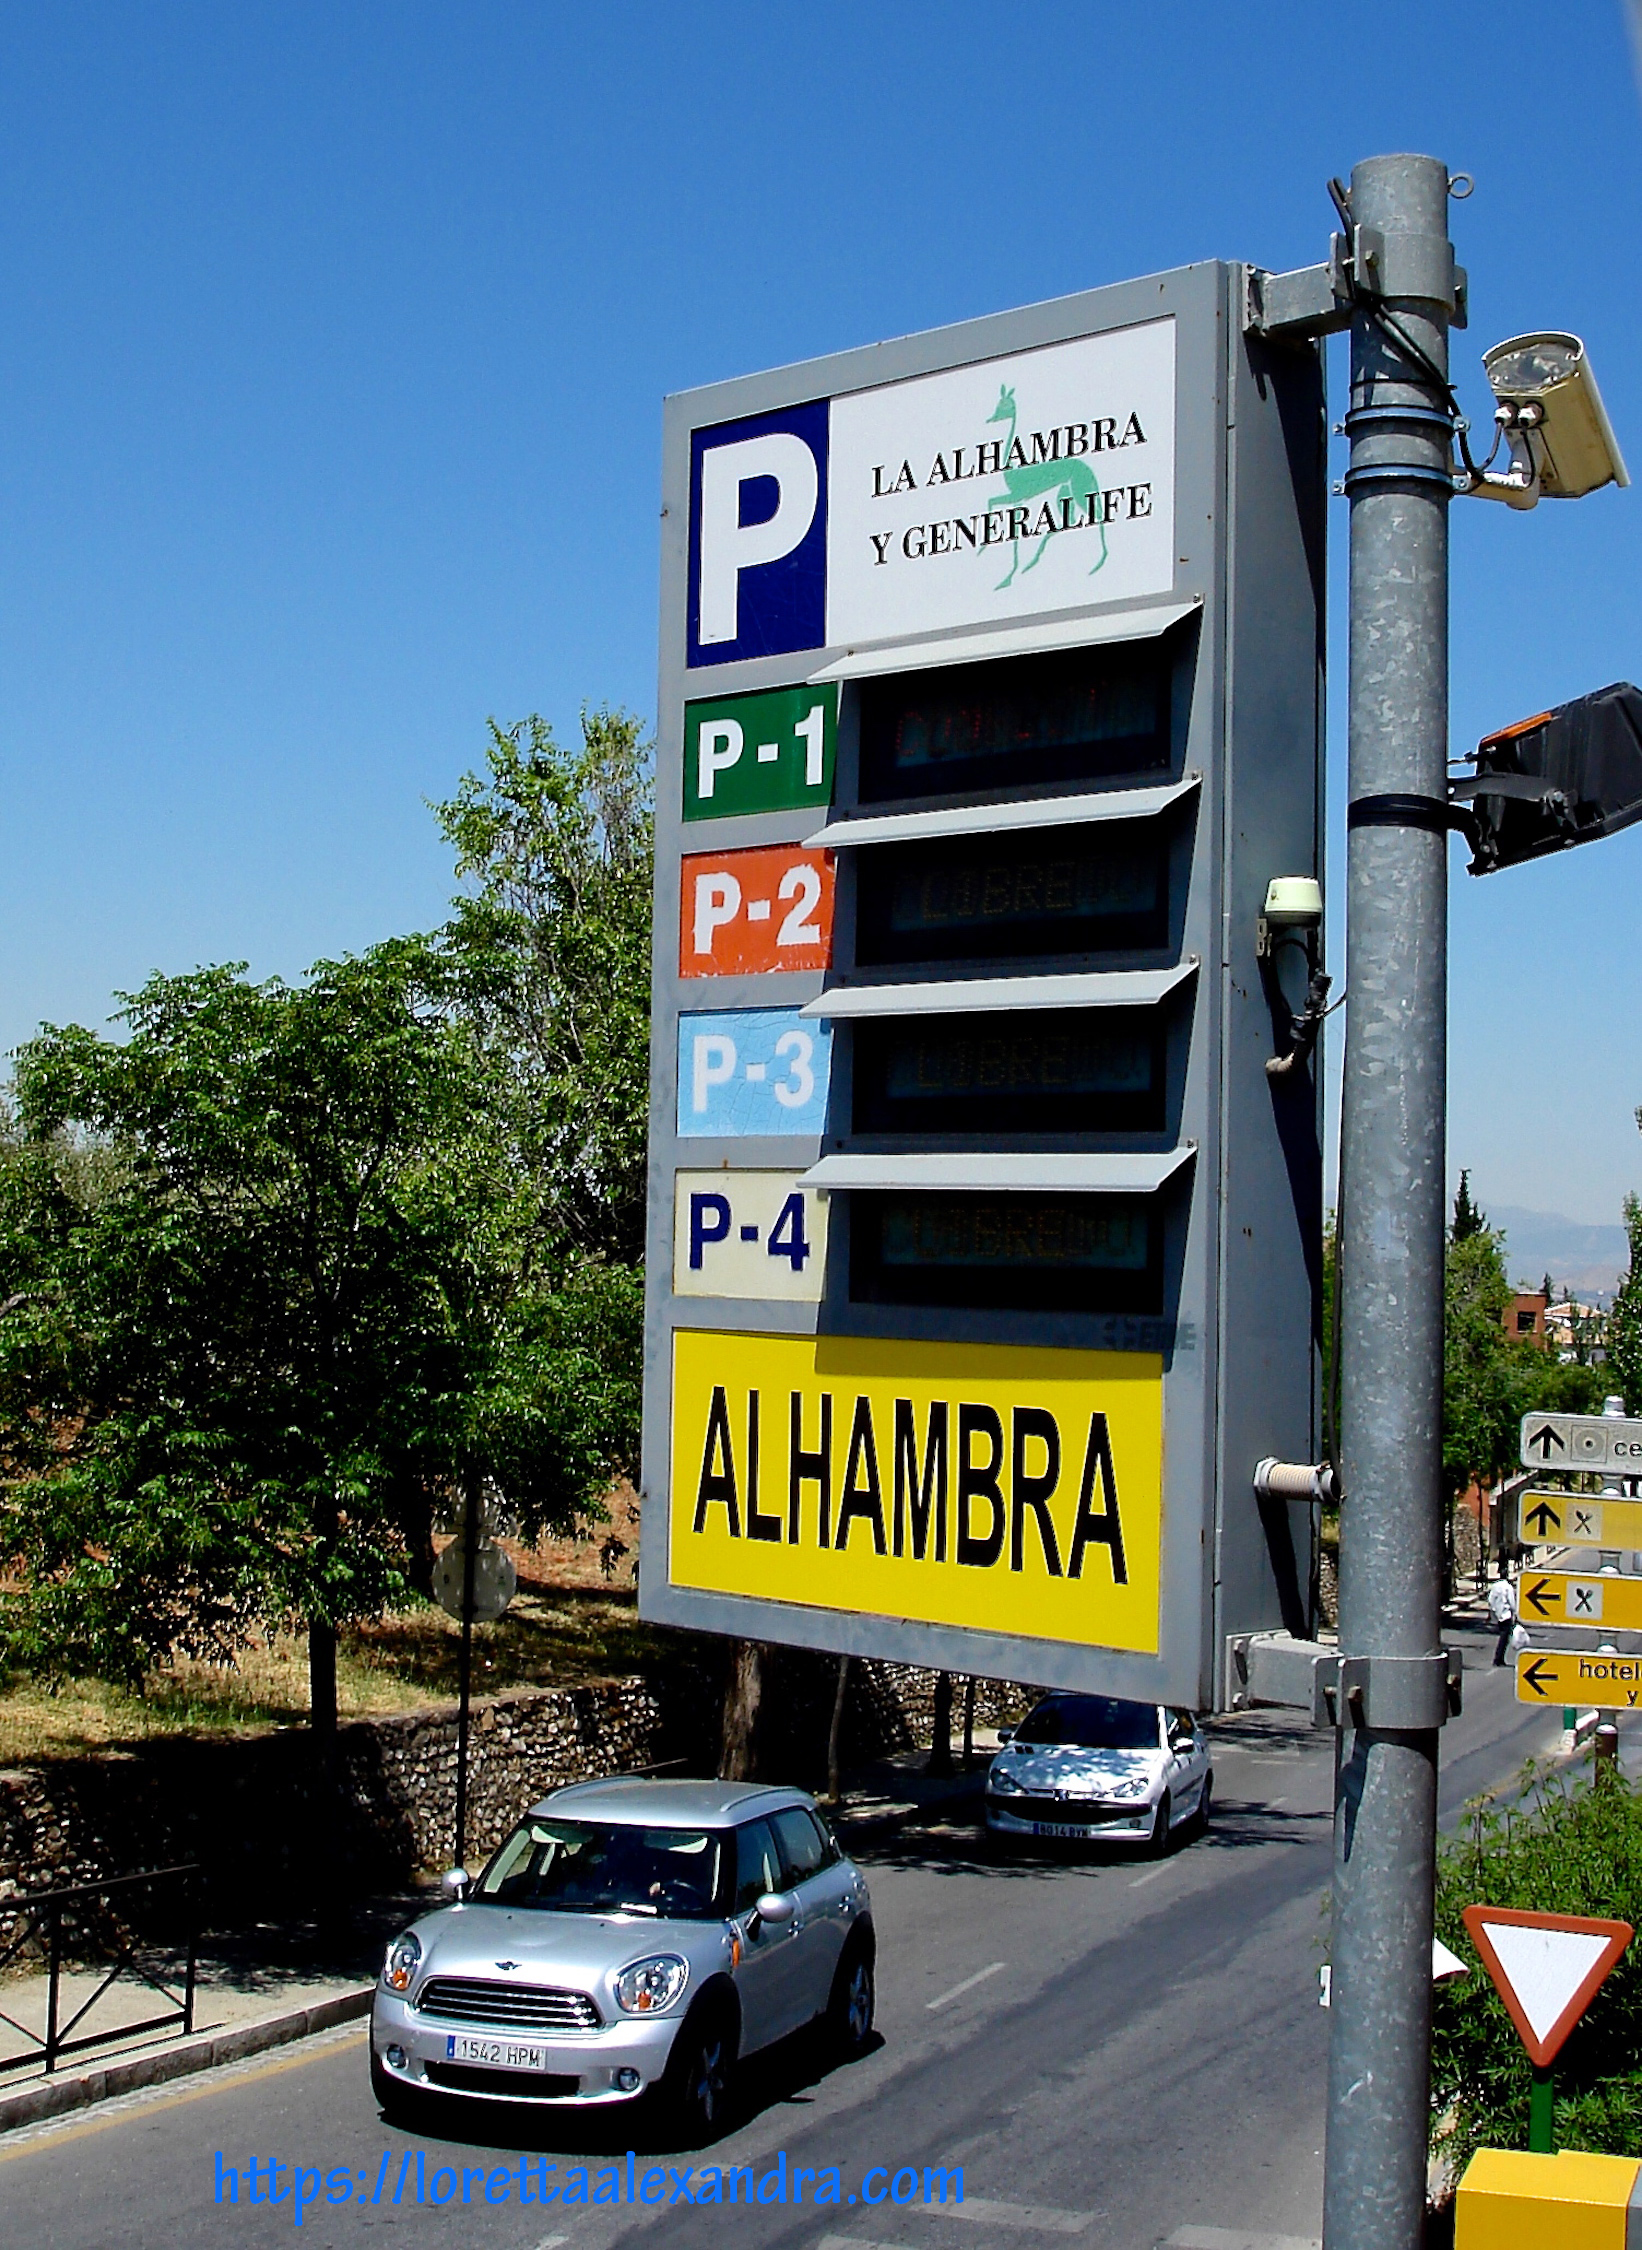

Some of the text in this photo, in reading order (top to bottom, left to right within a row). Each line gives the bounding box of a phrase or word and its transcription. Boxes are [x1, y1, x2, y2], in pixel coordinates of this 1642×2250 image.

[871, 411, 1148, 498] LA ALHAMBRA
[699, 432, 819, 646] P
[869, 483, 1154, 566] Y GENERALIFE
[692, 1385, 1129, 1585] ALHAMBRA
[1579, 1658, 1642, 1682] hotel
[462, 2039, 540, 2067] 1542 HPM
